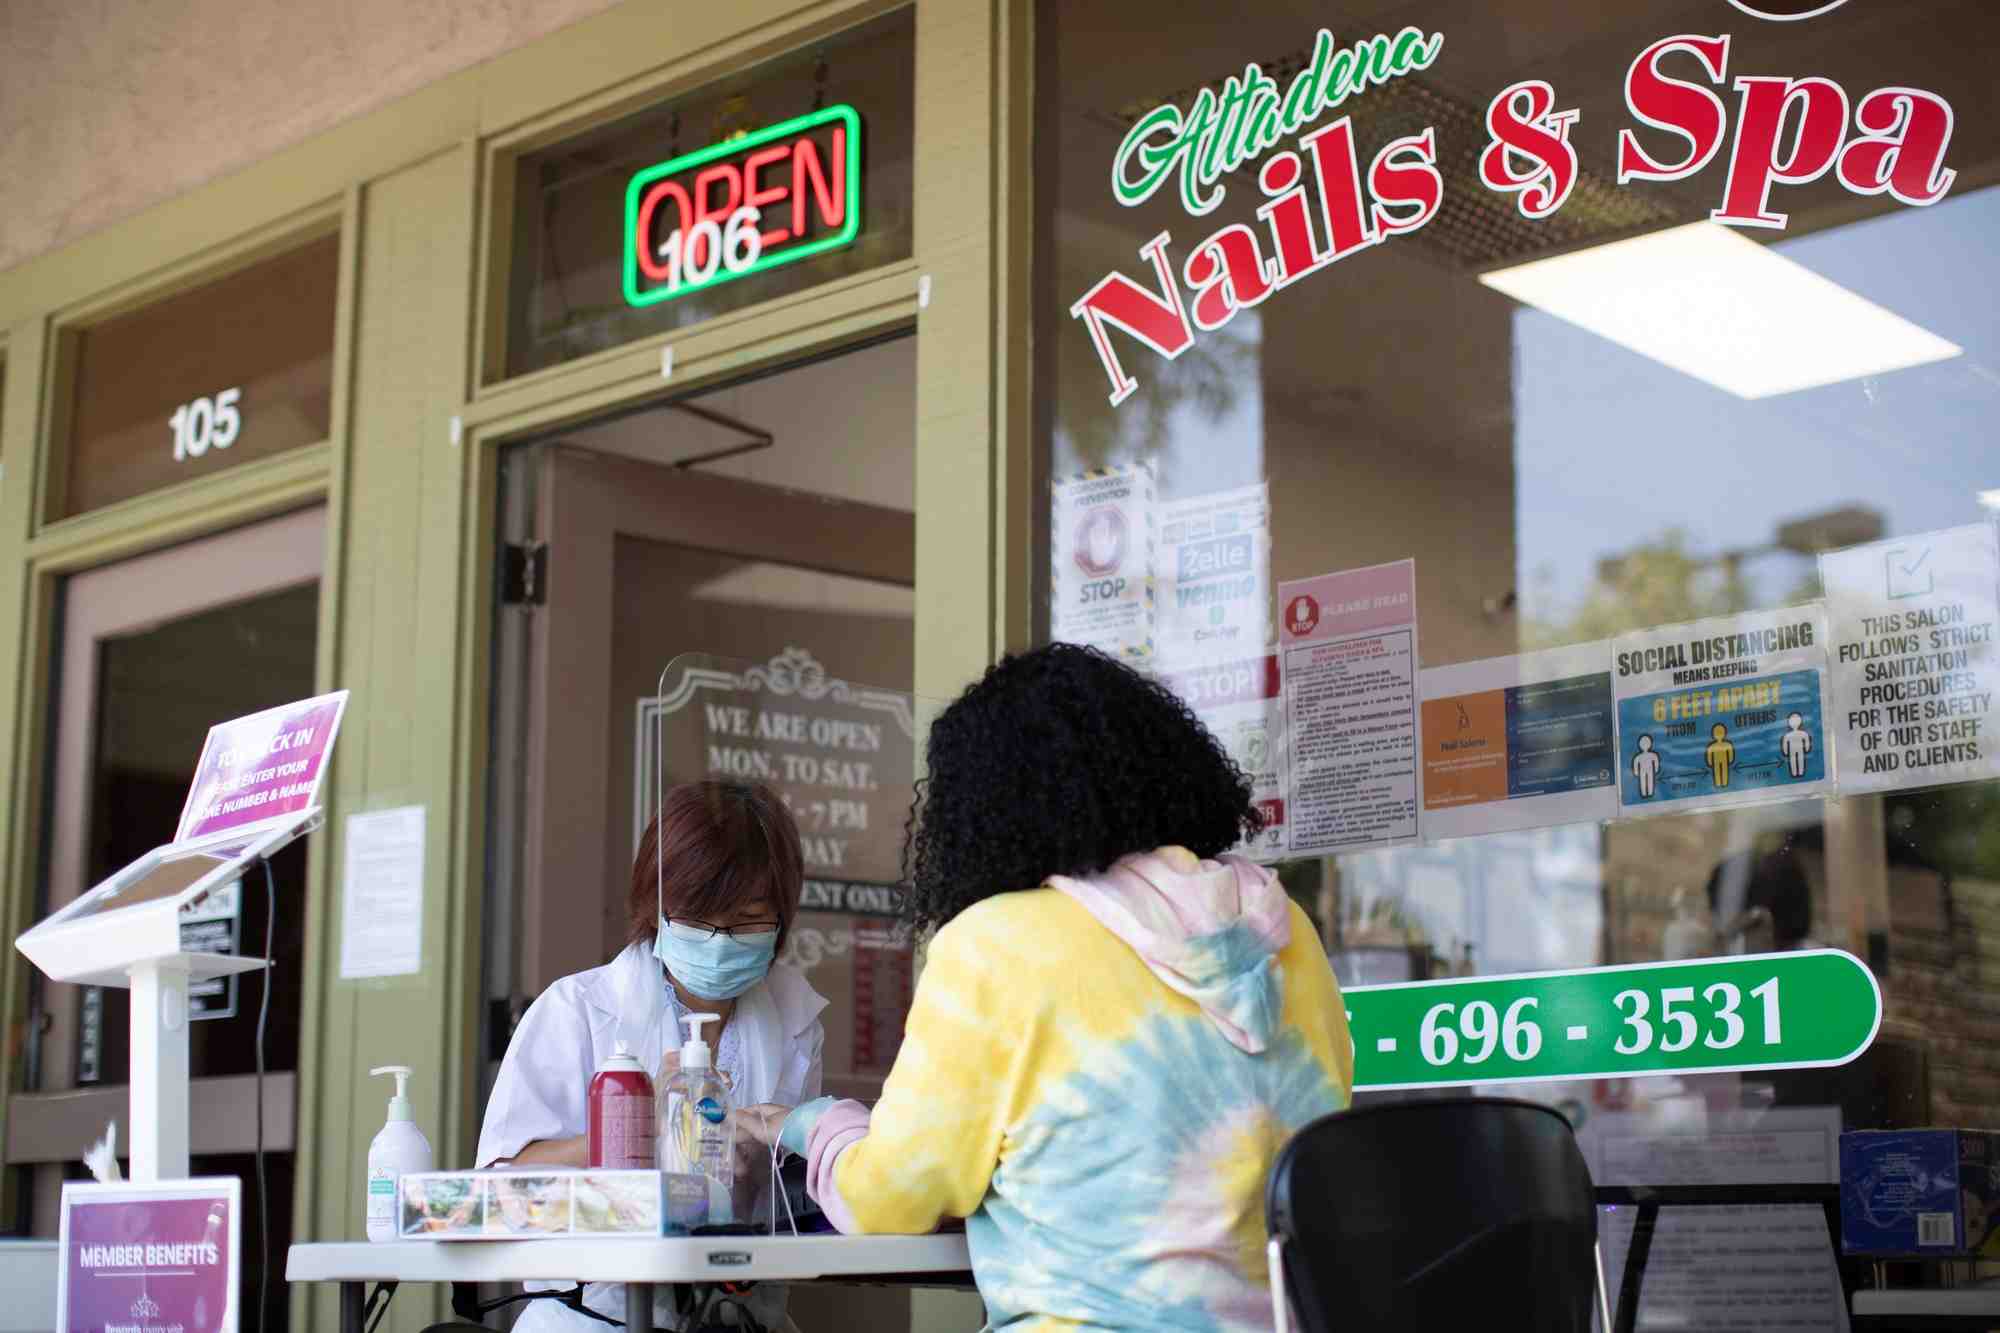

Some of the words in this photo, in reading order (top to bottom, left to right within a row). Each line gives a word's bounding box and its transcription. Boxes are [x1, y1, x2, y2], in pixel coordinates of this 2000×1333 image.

[638, 127, 846, 282] OPEN
[1068, 115, 1444, 407] Nails
[1478, 79, 1580, 219] &
[1617, 33, 1958, 230] Spa
[659, 206, 763, 292] 106
[168, 387, 242, 461] 105
[1184, 542, 1246, 575] Zelle
[1079, 578, 1126, 603] STOP
[1861, 614, 1901, 637] THIS
[1905, 605, 1964, 631] SALON
[1618, 643, 1687, 677] SOCIAL
[1691, 622, 1814, 665] DISTANCING
[1839, 633, 1920, 663] FOLLOWS
[1929, 623, 1993, 650] STRICT
[1673, 667, 1710, 685] MEANS
[1712, 660, 1758, 680] KEEPING
[1865, 649, 1969, 682] SANITATION
[1671, 688, 1713, 720] FEET
[1860, 671, 1976, 706] PROCEDURES
[705, 703, 750, 735] WE
[754, 711, 808, 743] ARE
[811, 718, 881, 751] OPEN
[1735, 710, 1777, 728] OTHERS
[1848, 707, 1882, 731] FOR
[1886, 702, 1919, 725] THE
[1924, 692, 1993, 719] SAFETY
[292, 727, 315, 748] IN
[1860, 730, 1882, 751] OF
[1888, 725, 1923, 747] OUR
[1927, 717, 1983, 742] STAFF
[241, 768, 276, 787] ENTER
[277, 759, 309, 779] YOUR
[708, 745, 778, 780] MON.
[782, 754, 818, 784] TO
[821, 759, 879, 791] SAT.
[1863, 753, 1899, 774] AND
[1904, 742, 1983, 769] CLIENTS.
[223, 790, 268, 814] NUMBER
[279, 779, 316, 799] NAME
[830, 800, 867, 831] PM
[1419, 996, 1543, 1066] 696
[1612, 976, 1783, 1056] 3531
[80, 1245, 143, 1268] MEMBER
[146, 1242, 220, 1267] BENEFITS
